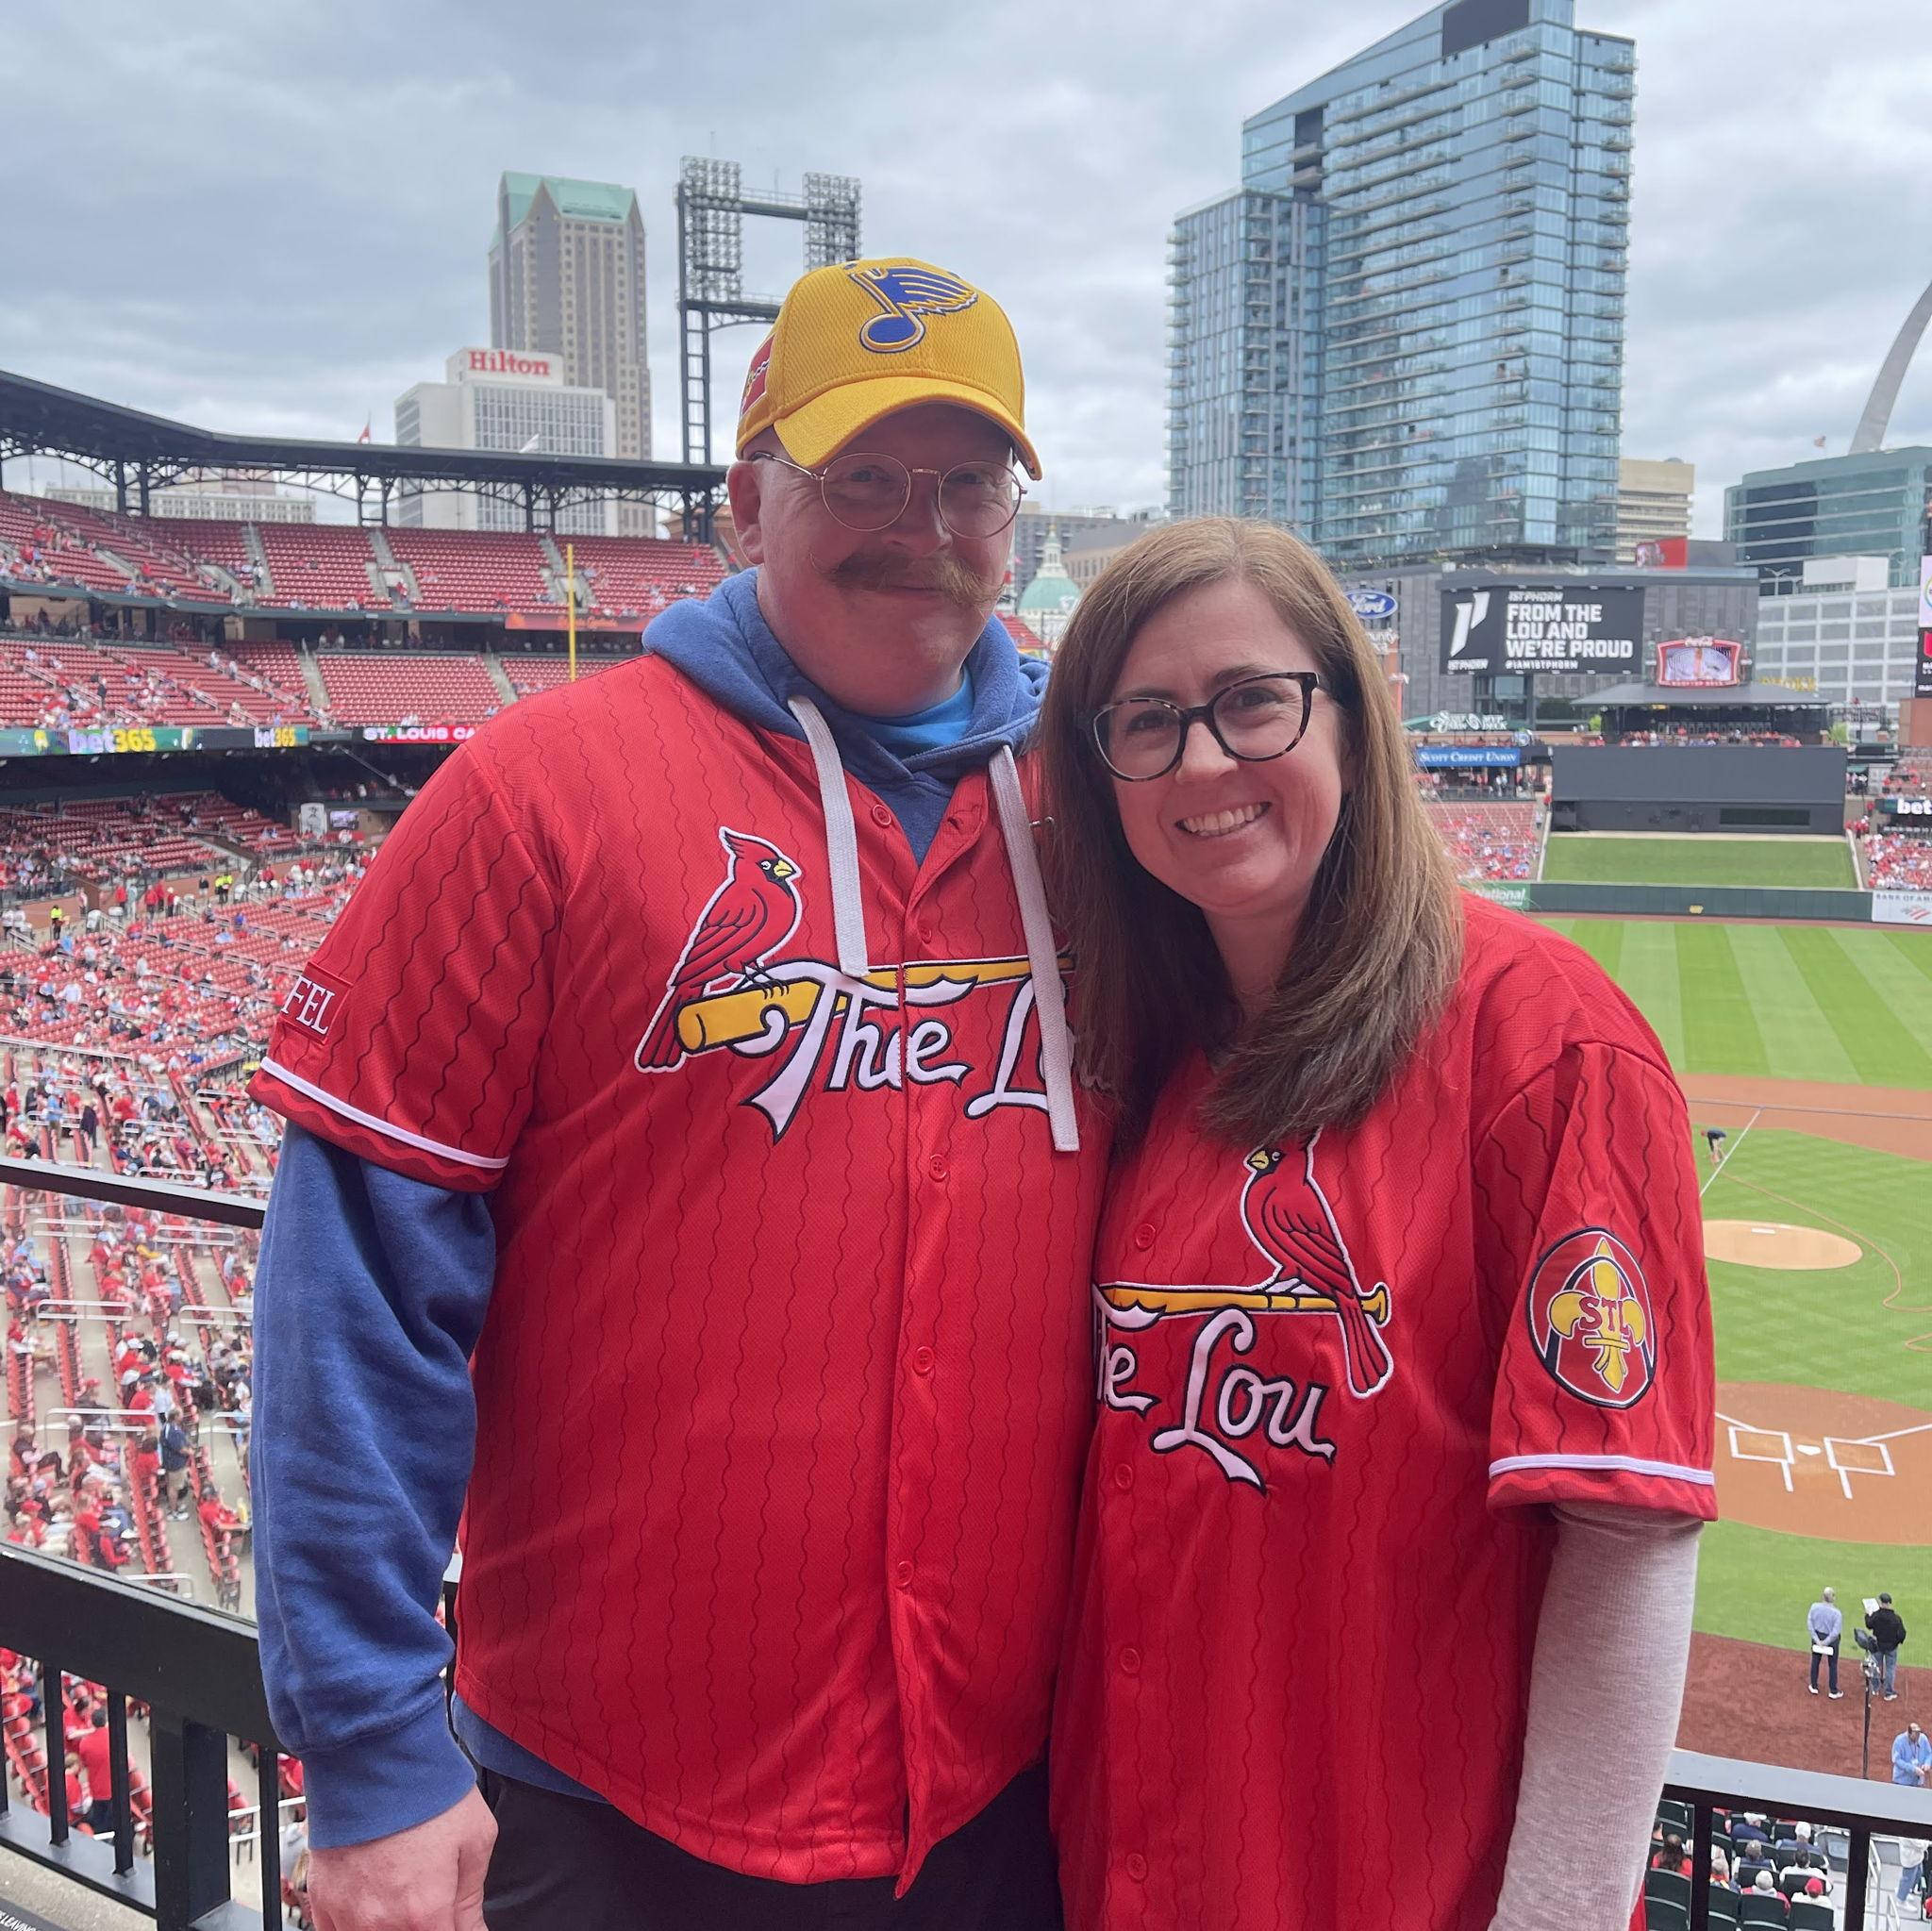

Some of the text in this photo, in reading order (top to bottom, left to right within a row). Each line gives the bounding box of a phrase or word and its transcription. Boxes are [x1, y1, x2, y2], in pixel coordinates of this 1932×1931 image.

[468, 348, 551, 376] Hilton
[1507, 604, 1603, 623] FROM THE
[1507, 622, 1589, 640] LOU AND
[1506, 640, 1634, 658] WE'RE PROUD
[68, 727, 157, 755] bet365
[254, 726, 295, 748] bet365
[363, 726, 392, 741] ST.
[396, 726, 449, 741] LOUIS
[1420, 750, 1517, 762] SCOTT CREDIT UNION
[730, 957, 979, 1144] The
[1578, 1296, 1630, 1336] STL
[1149, 1304, 1338, 1498] Lou
